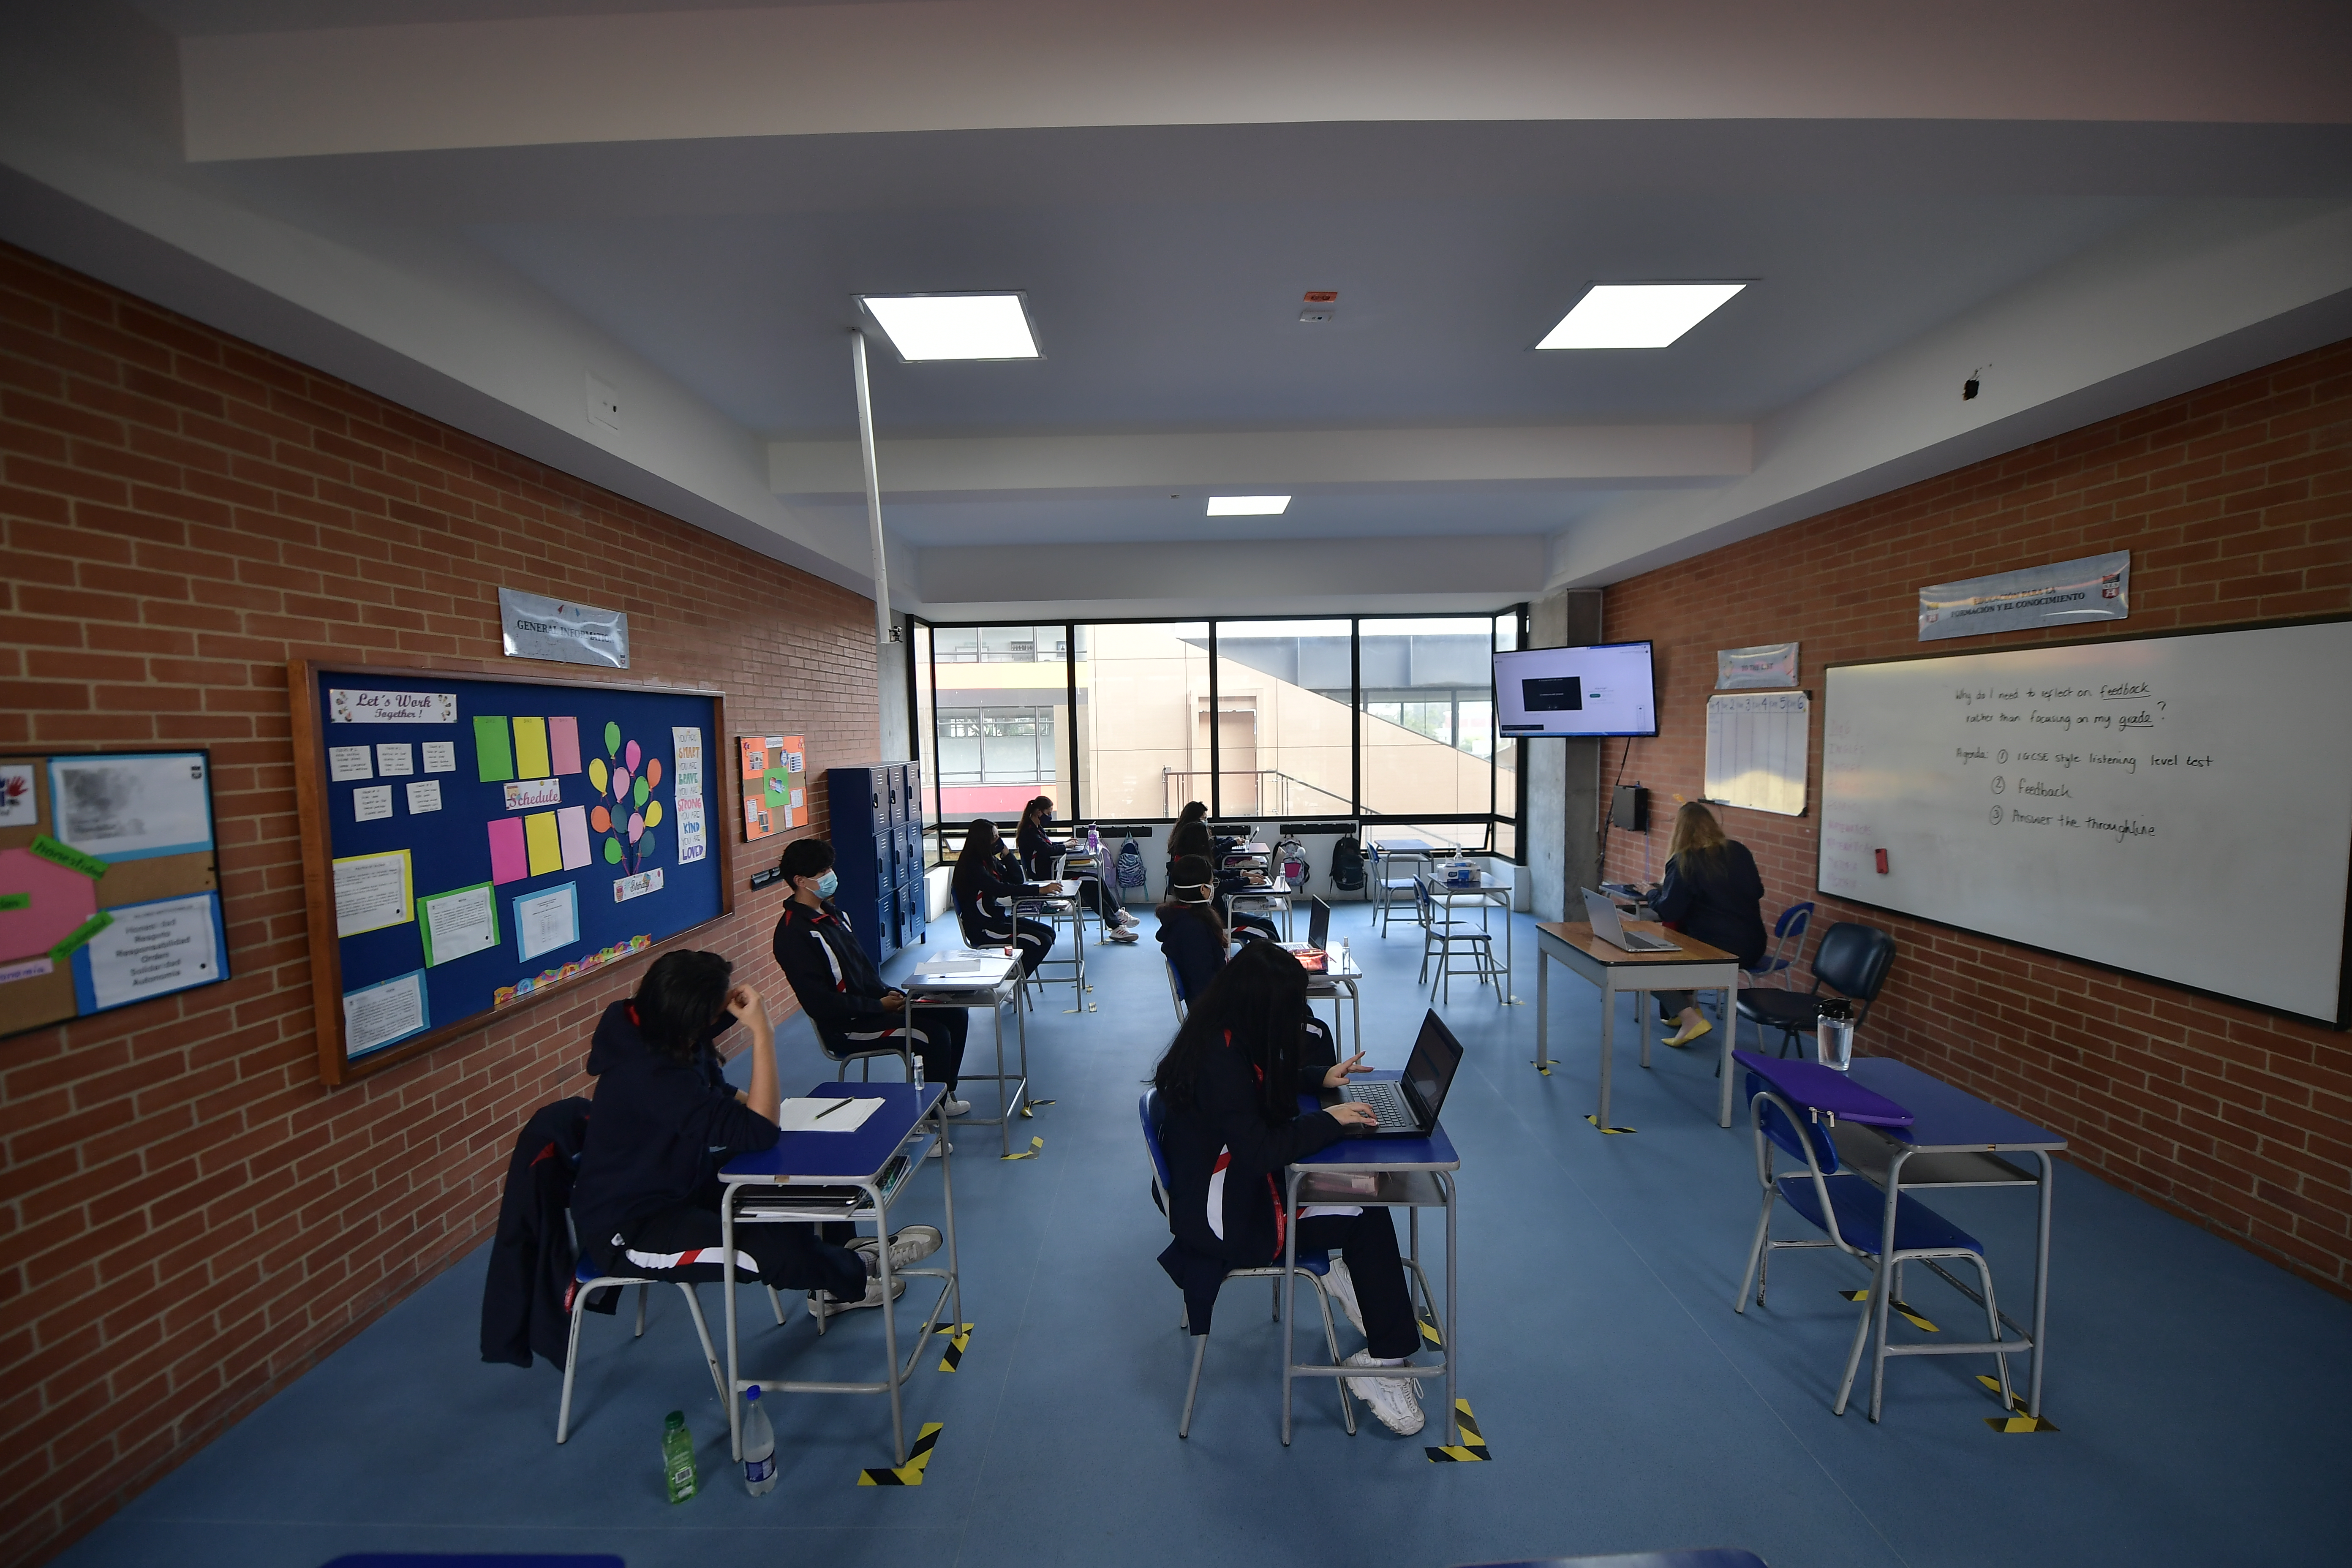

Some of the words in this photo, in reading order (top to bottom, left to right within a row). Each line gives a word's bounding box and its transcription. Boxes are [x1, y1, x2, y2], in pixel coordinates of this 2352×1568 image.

[1997, 603, 2004, 611] Y
[2004, 602, 2013, 610] EL
[2015, 592, 2085, 608] CONOCIMIENTO
[517, 620, 558, 635] GENERAL
[1976, 691, 1986, 700] do
[1998, 688, 2019, 700] need
[2026, 688, 2035, 697] to
[2042, 687, 2074, 701] reflect
[2077, 689, 2093, 697] on
[2099, 682, 2151, 698] feedback
[395, 694, 432, 708] Work
[1730, 699, 1734, 710] 2
[1761, 698, 1767, 710] 4
[1780, 697, 1786, 709] 5
[1798, 696, 1804, 709] 6
[1965, 712, 1993, 724] rather
[1999, 712, 2020, 723] than
[2030, 710, 2071, 731] focusing
[2076, 716, 2089, 724] on
[2093, 715, 2111, 729] my
[679, 747, 700, 759] SMART
[2017, 752, 2049, 762] IGCSE
[2055, 754, 2081, 768] style
[2089, 751, 2137, 774] listening
[2151, 754, 2178, 766] level
[2186, 755, 2214, 767] test
[678, 773, 698, 784] BRAVE
[509, 789, 558, 807] Schedule
[678, 798, 702, 811] STRONG
[2012, 808, 2054, 825] Answer
[2057, 814, 2081, 828] the
[682, 845, 703, 860] LOVED
